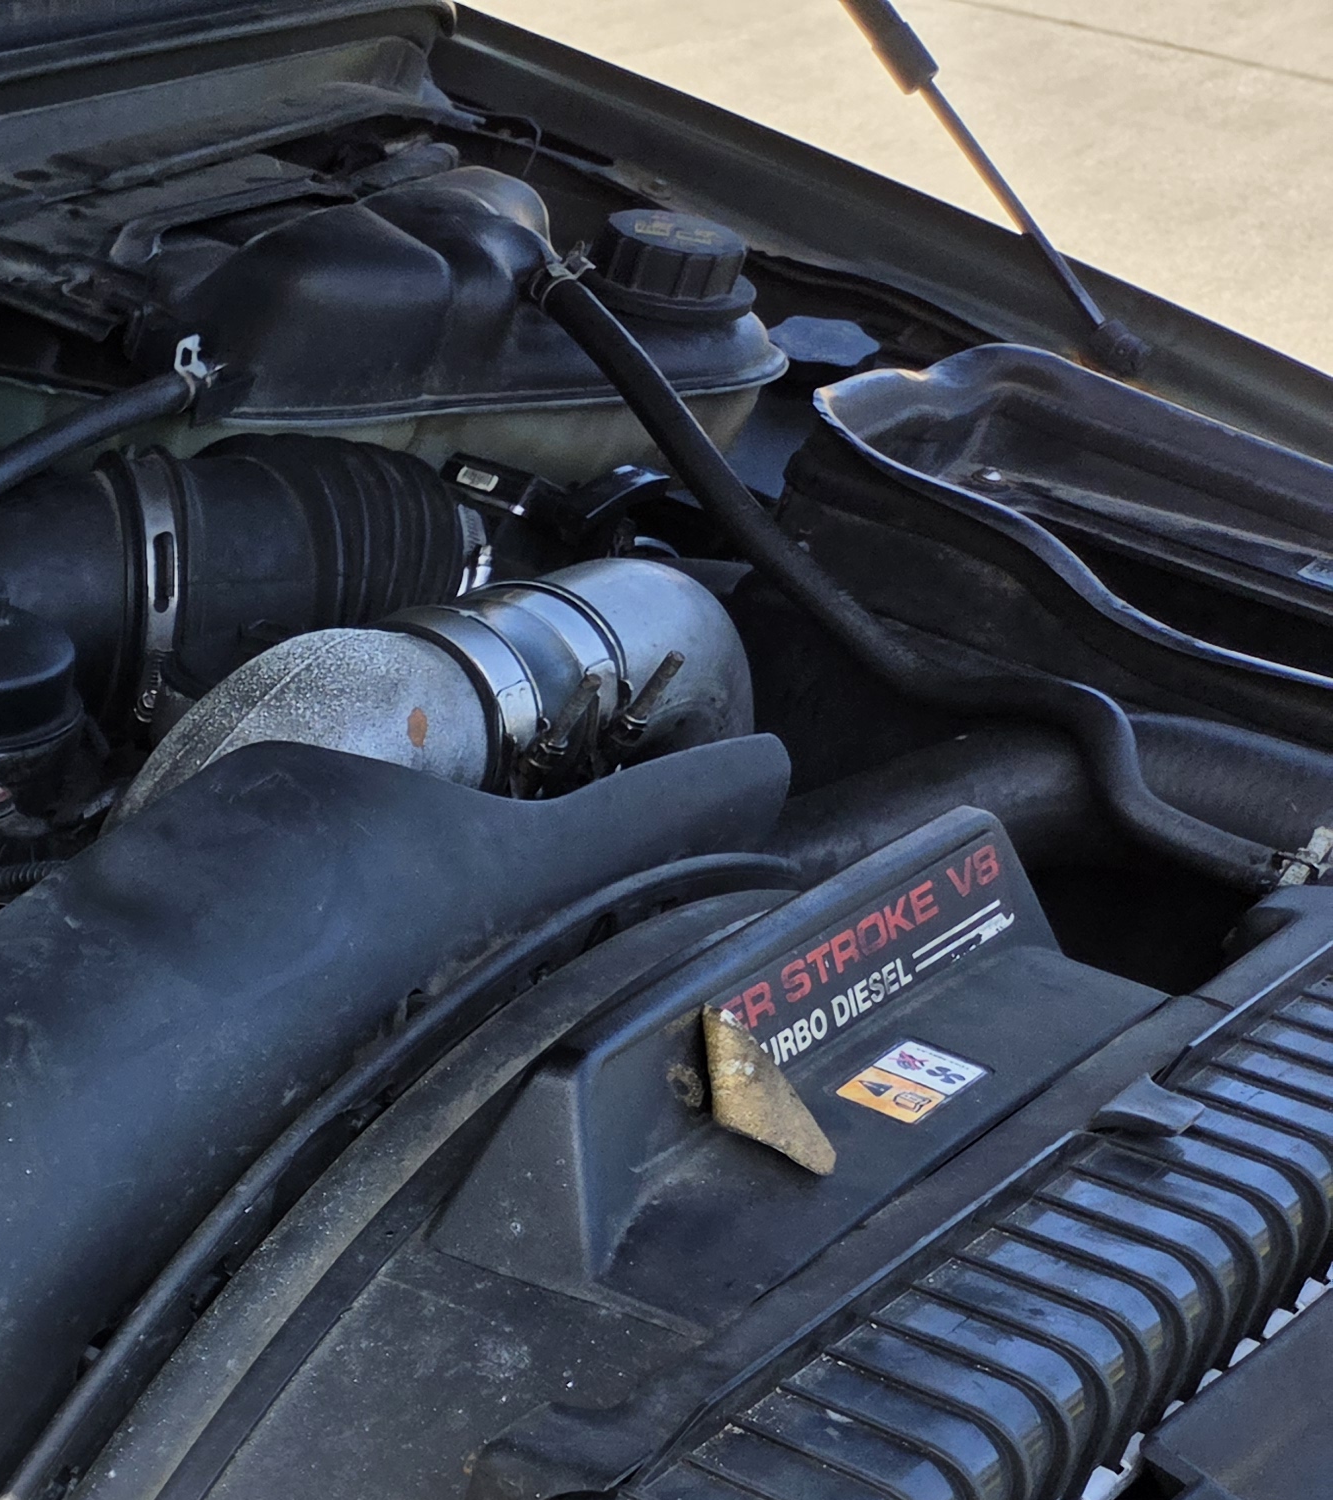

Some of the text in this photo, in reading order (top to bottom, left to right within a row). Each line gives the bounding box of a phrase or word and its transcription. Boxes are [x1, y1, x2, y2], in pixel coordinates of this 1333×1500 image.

[775, 843, 1006, 1004] STROKE V8
[759, 955, 913, 1069] URBO DIESEL
